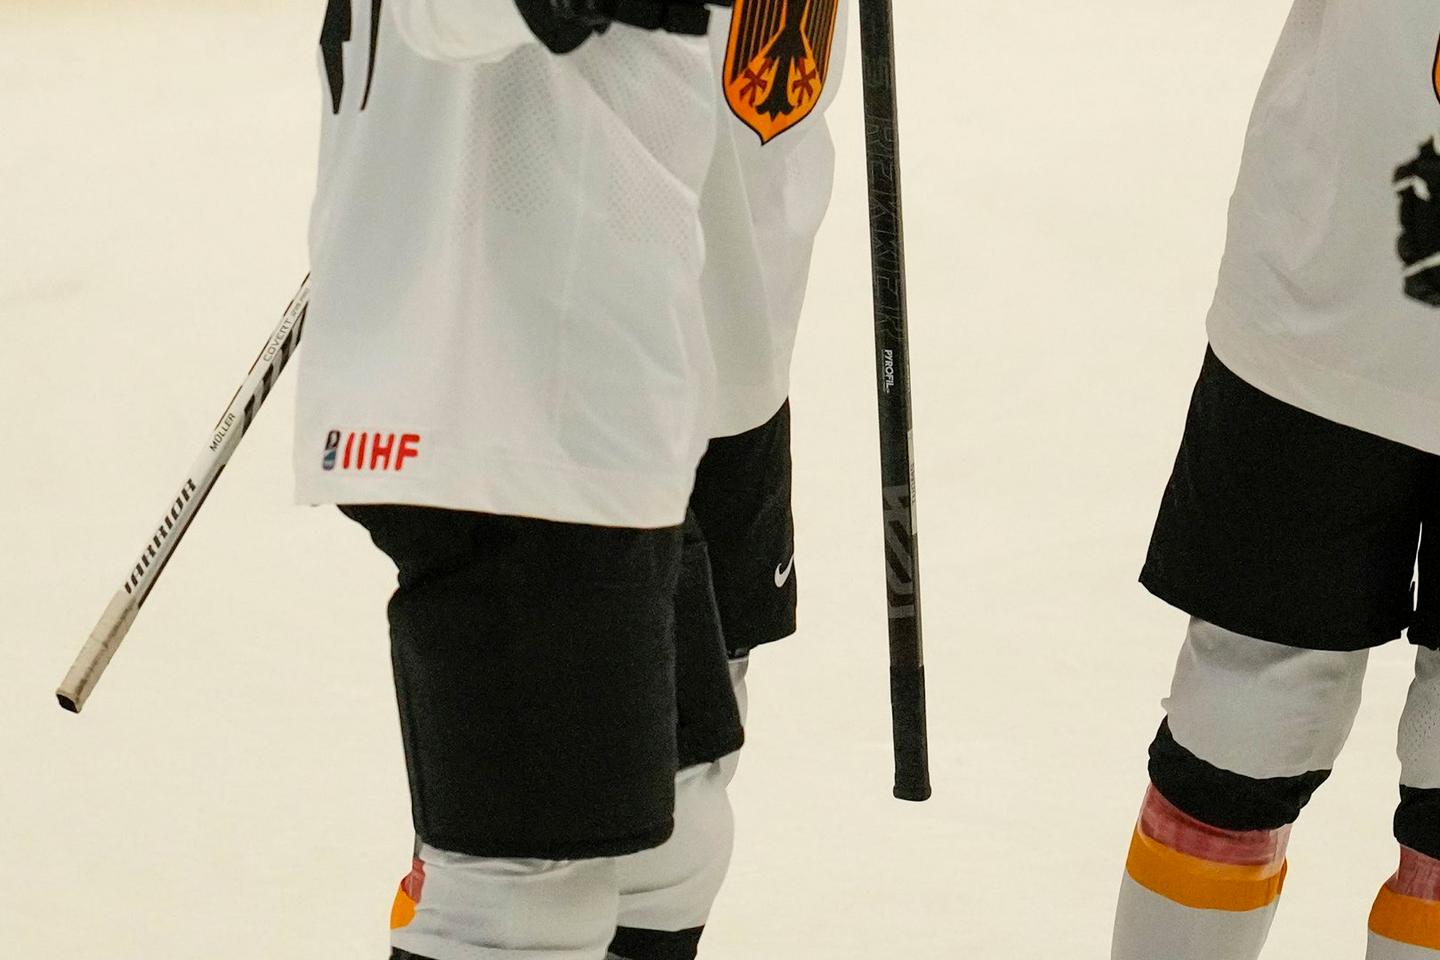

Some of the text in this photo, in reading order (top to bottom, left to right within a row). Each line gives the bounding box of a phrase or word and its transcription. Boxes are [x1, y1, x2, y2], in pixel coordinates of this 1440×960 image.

[263, 318, 292, 363] COVERT
[883, 349, 895, 390] PYROFIL
[342, 431, 421, 471] IIHF
